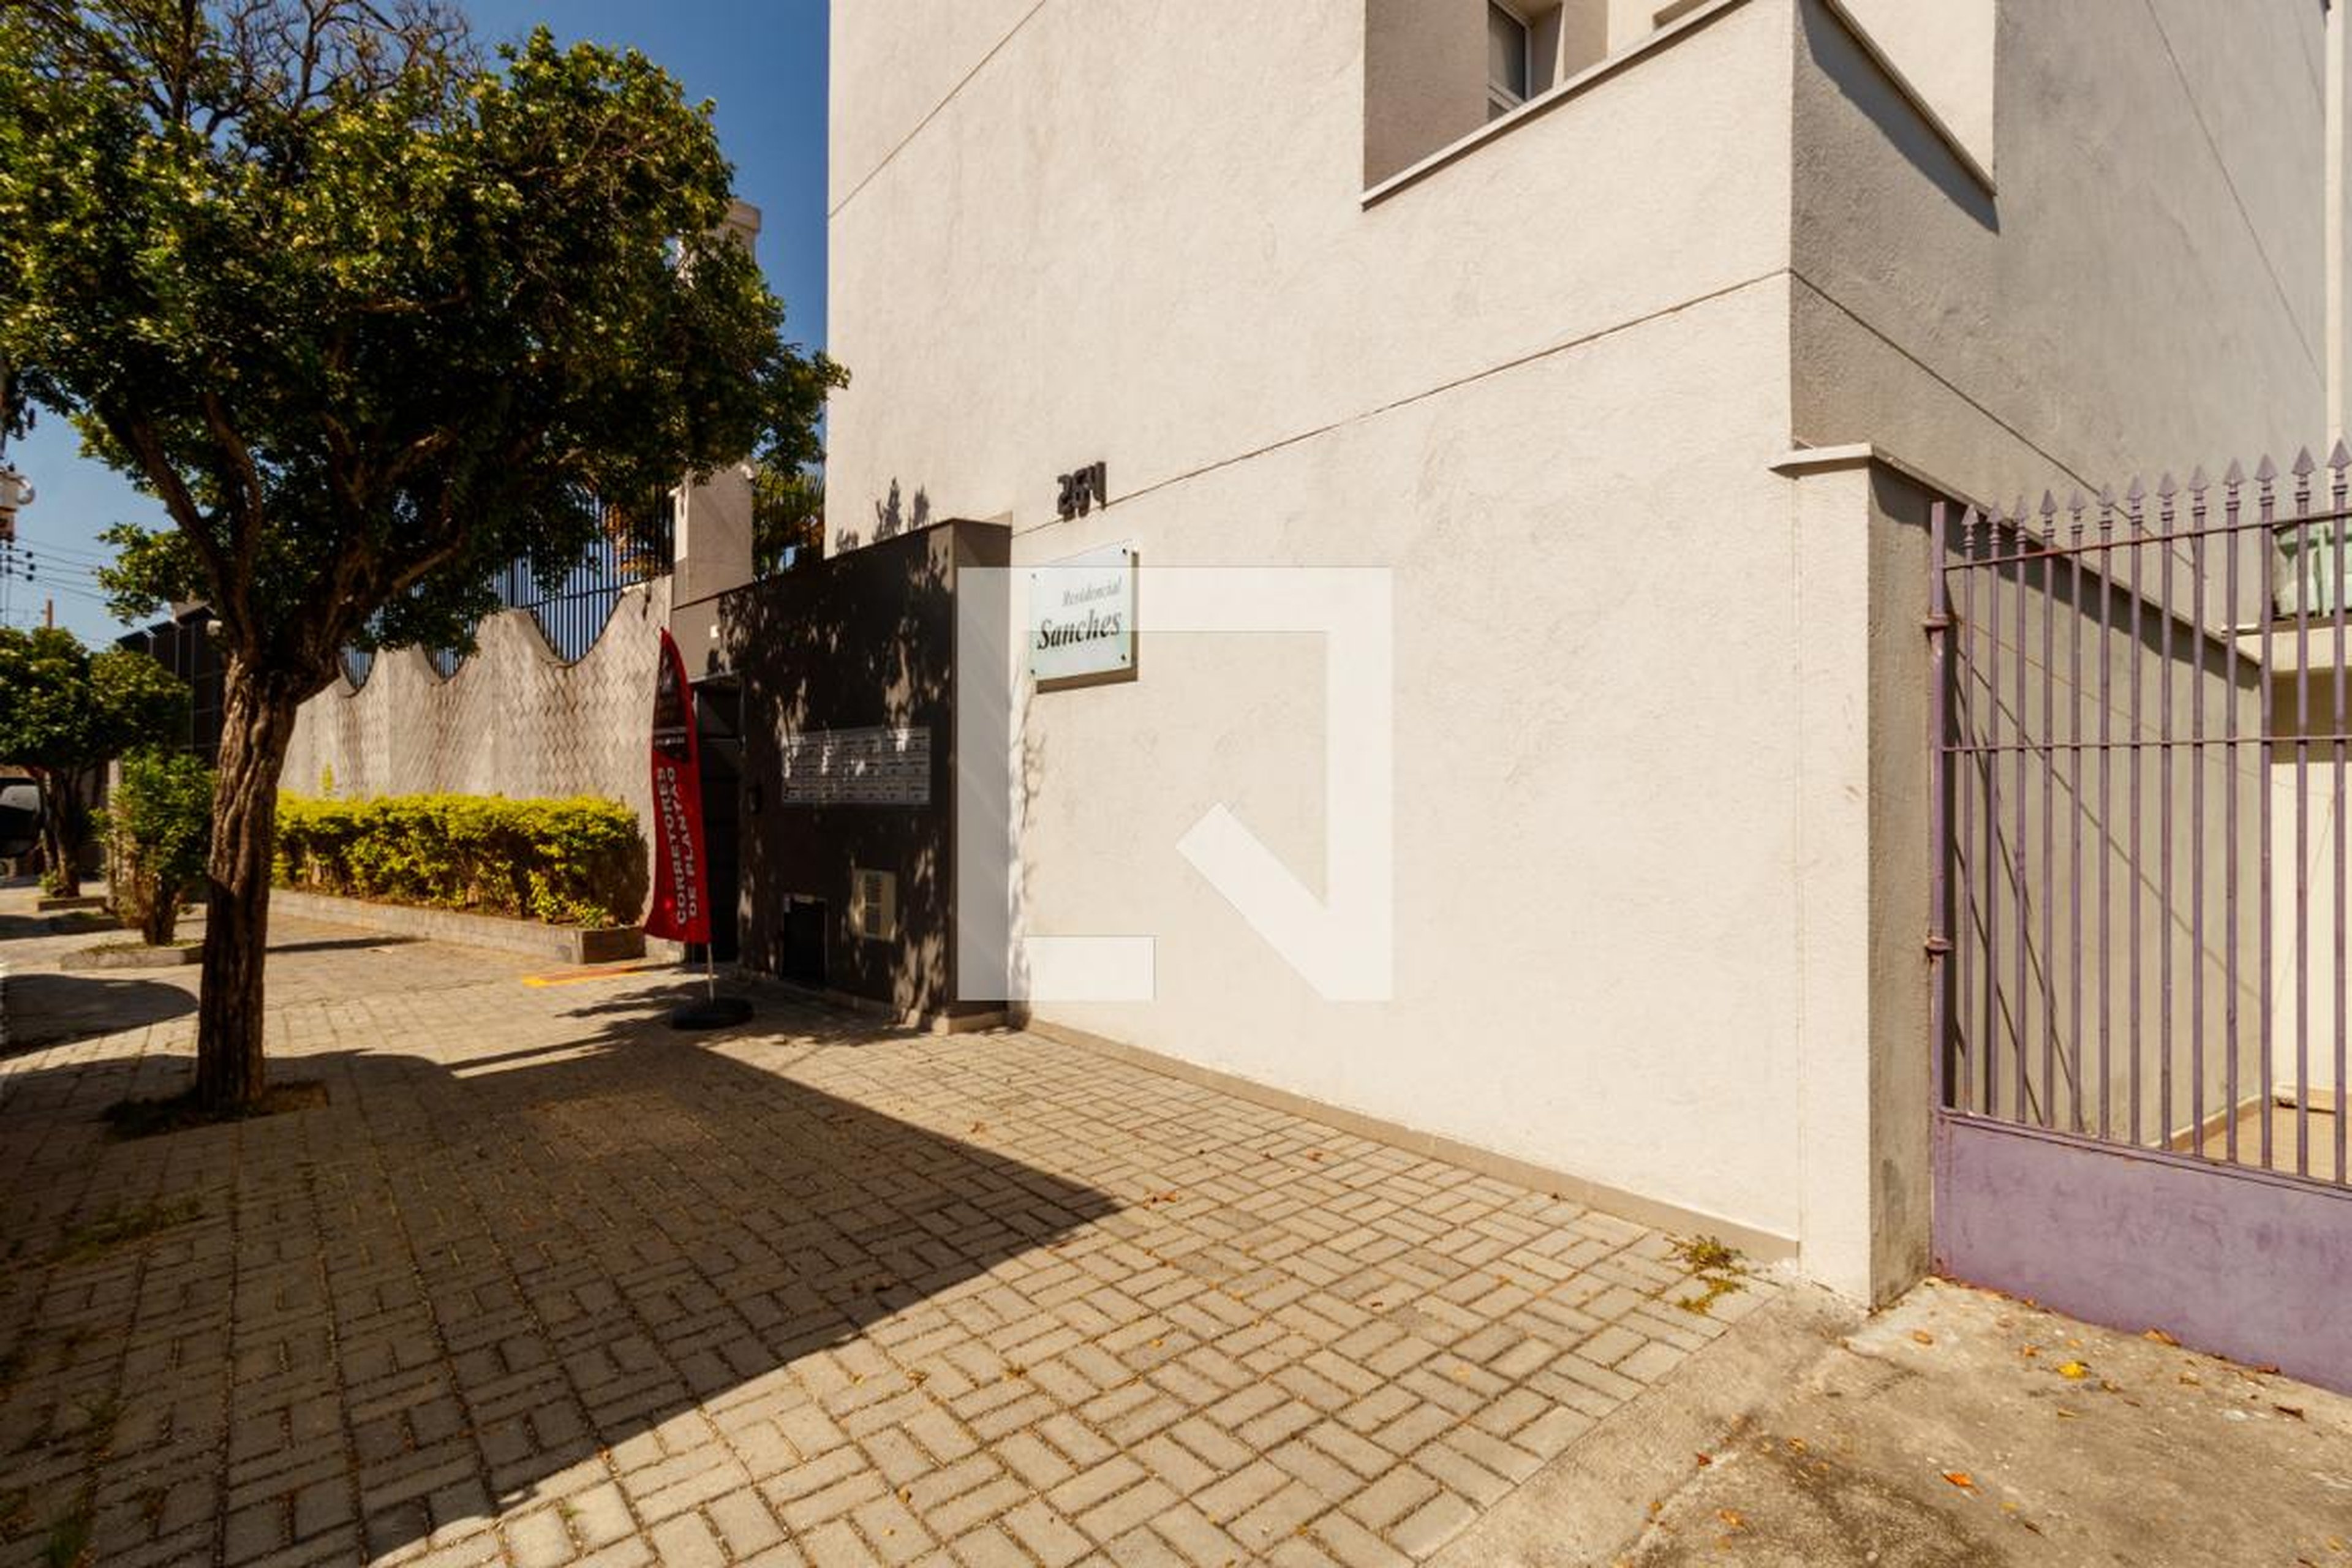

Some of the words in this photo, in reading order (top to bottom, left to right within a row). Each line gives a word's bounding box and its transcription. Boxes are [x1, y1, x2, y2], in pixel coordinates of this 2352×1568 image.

[1062, 575, 1122, 606] Residencial
[1036, 609, 1122, 650] Sanches
[657, 767, 687, 925] CORRETORES
[688, 886, 698, 918] DE
